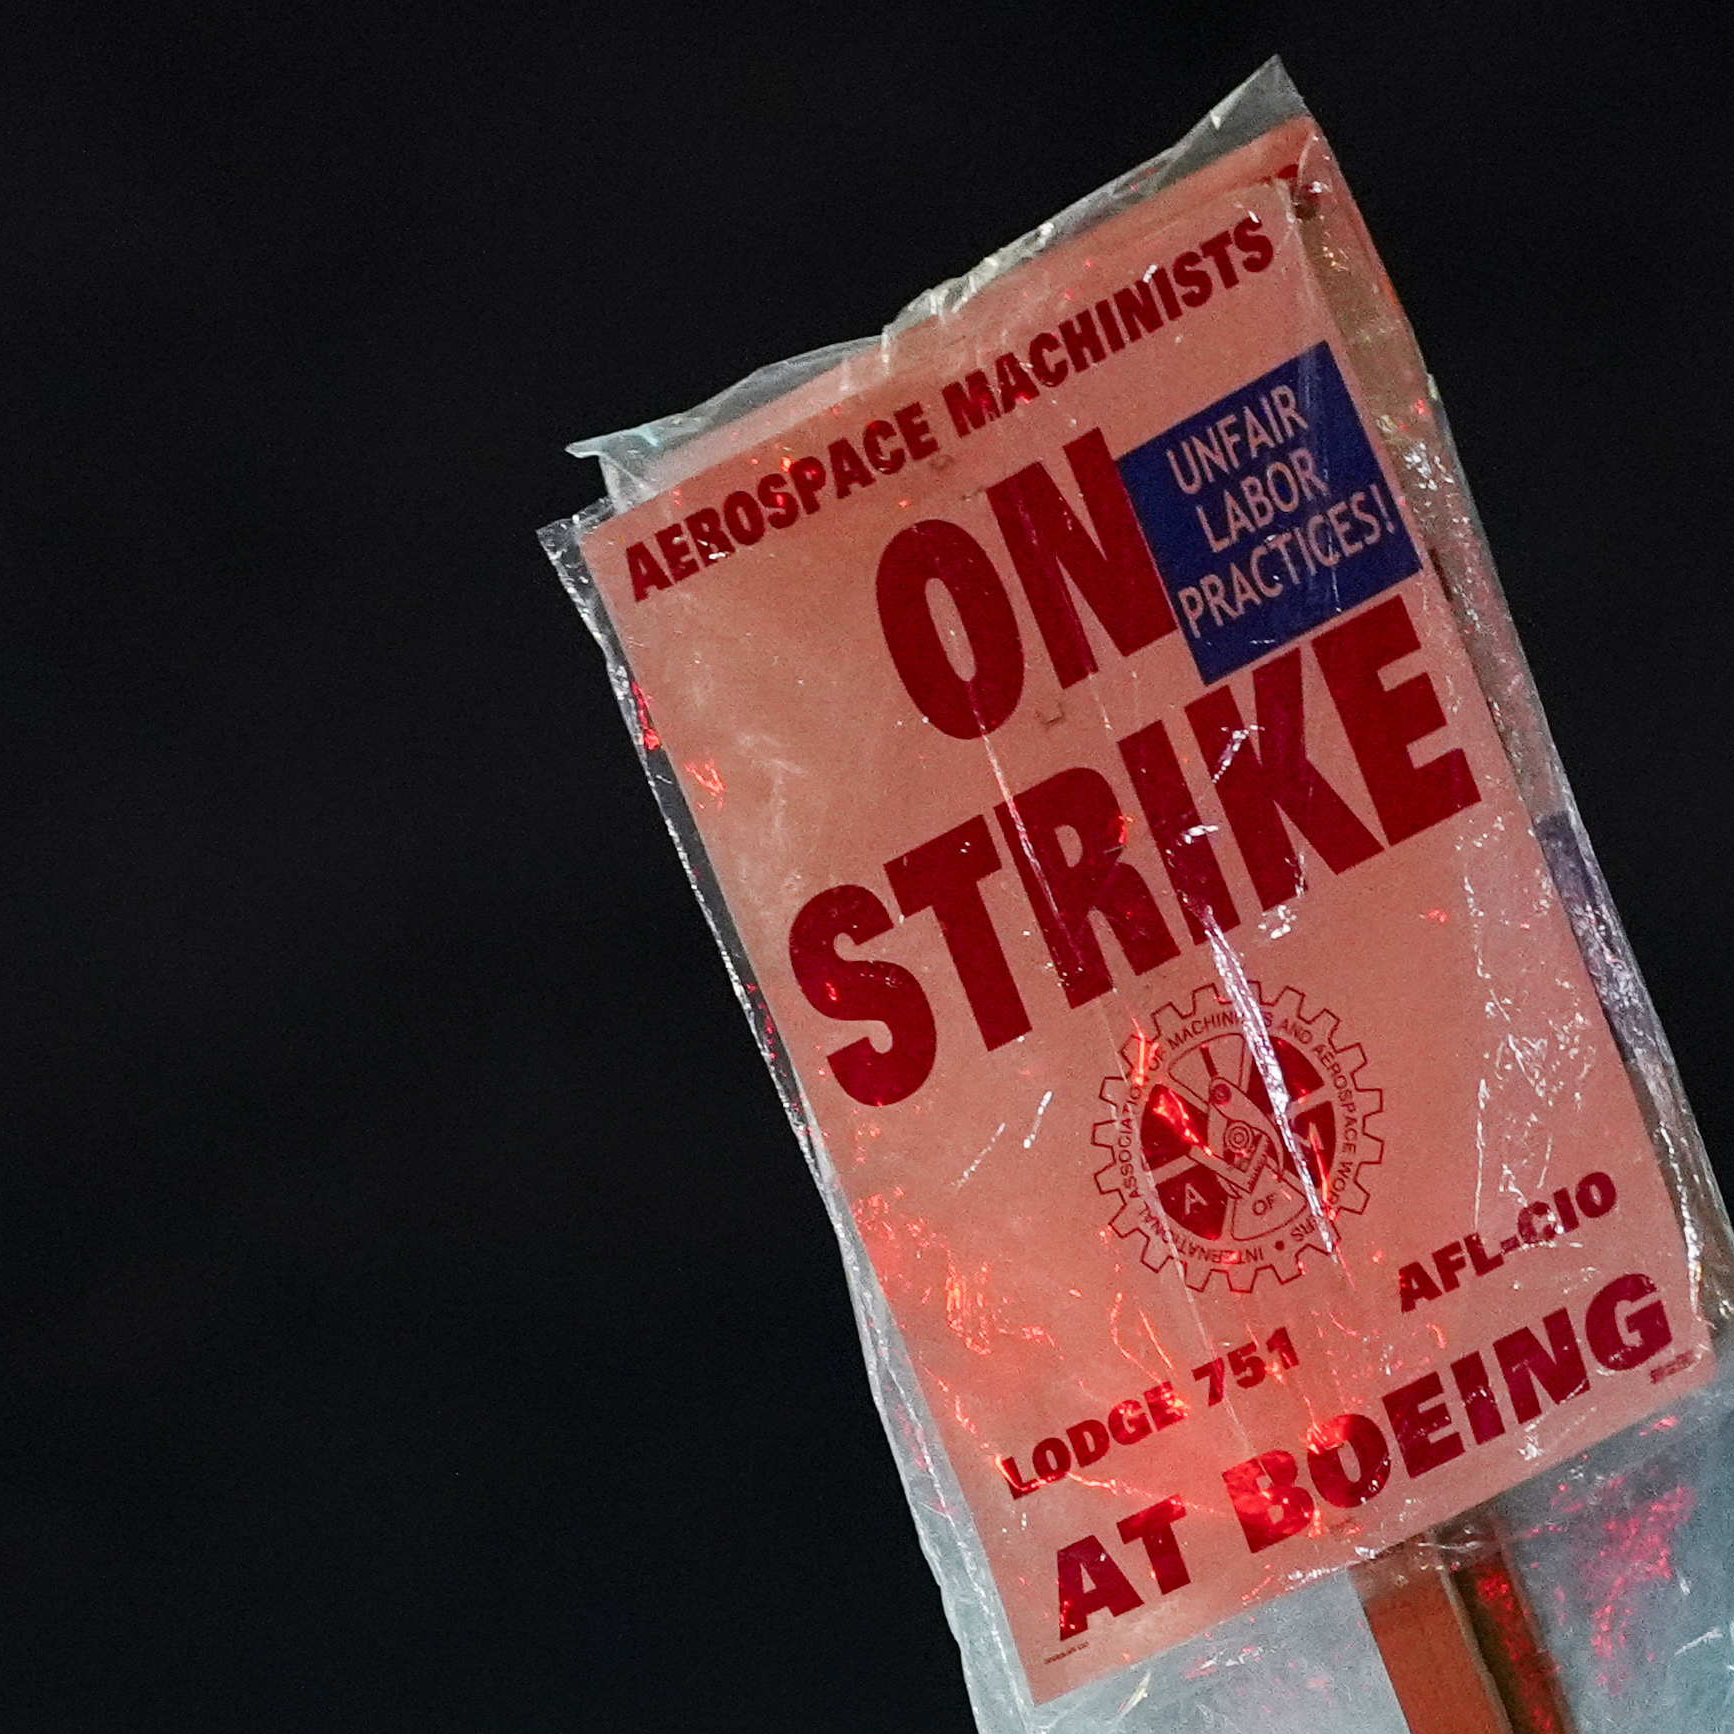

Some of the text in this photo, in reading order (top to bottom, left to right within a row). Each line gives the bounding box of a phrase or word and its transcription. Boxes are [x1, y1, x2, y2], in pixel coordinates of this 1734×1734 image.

[624, 214, 1275, 603] AEROSPACE MACHINISTS
[1166, 384, 1309, 496] UNFAIR
[1177, 484, 1396, 639] PRACTICES!
[1196, 447, 1331, 553] LABOR
[875, 426, 1178, 740] ON
[788, 595, 1483, 1107] STRIKE
[1117, 1078, 1143, 1199] ASSOCIATIO
[1279, 1017, 1314, 1045] AND
[1311, 1043, 1358, 1156] AEROSPACE
[1183, 1182, 1210, 1215] A
[1252, 1190, 1278, 1217] OF
[1398, 1171, 1618, 1313] AFL-CIO
[1001, 1326, 1300, 1500] LODGE 751
[1055, 1273, 1673, 1642] AT BOEING
